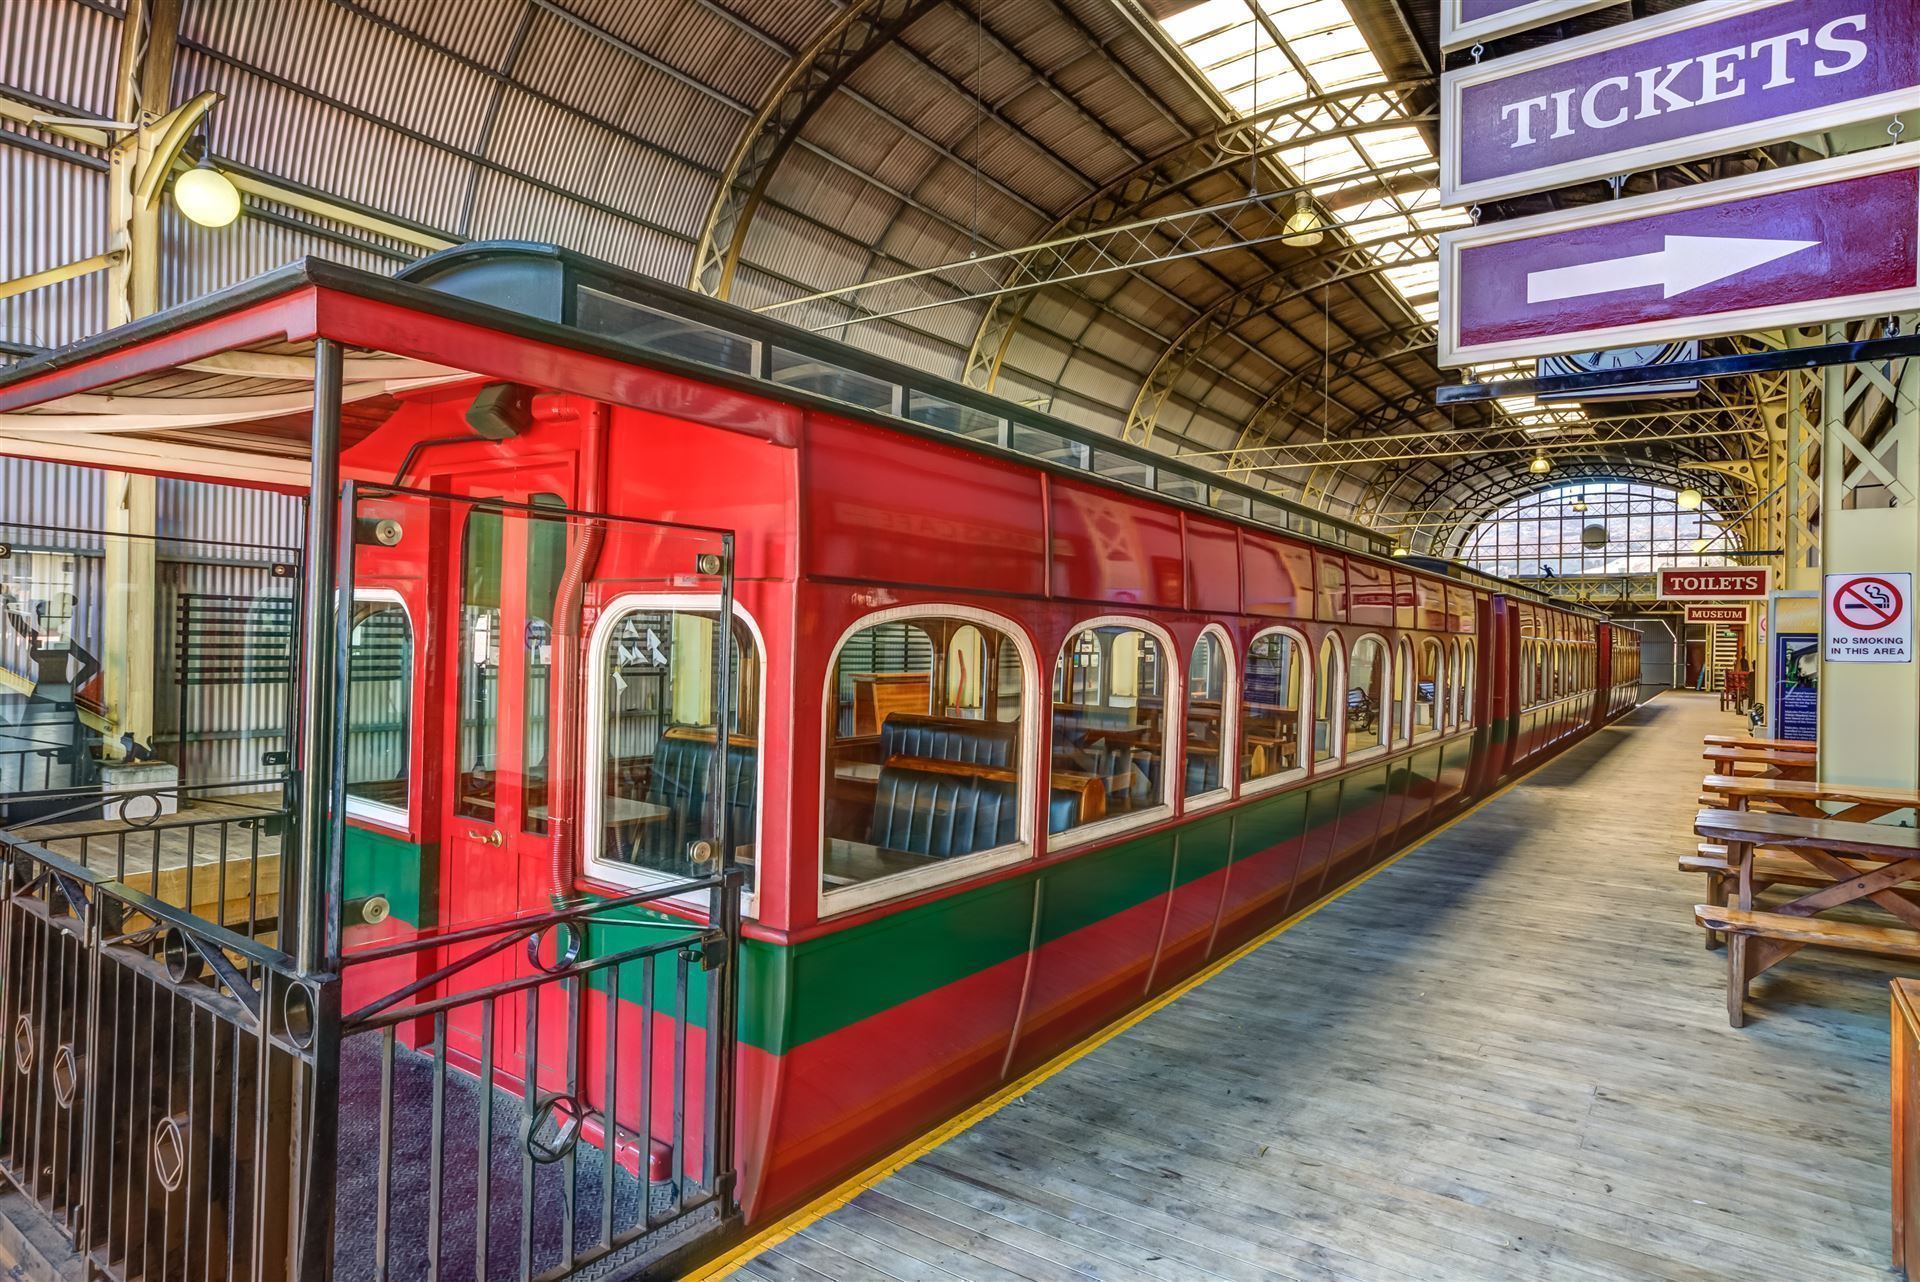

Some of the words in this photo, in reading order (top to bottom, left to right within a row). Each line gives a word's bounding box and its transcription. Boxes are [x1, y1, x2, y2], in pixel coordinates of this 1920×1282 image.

[1501, 14, 1868, 149] TICKETS
[1670, 576, 1758, 591] TOILETS
[1691, 610, 1743, 619] MUSEUM
[1832, 637, 1848, 645] NO
[1852, 637, 1904, 645] SMOKING
[1831, 647, 1841, 655] IN
[1845, 647, 1869, 655] THIS
[1873, 647, 1905, 655] AREA
